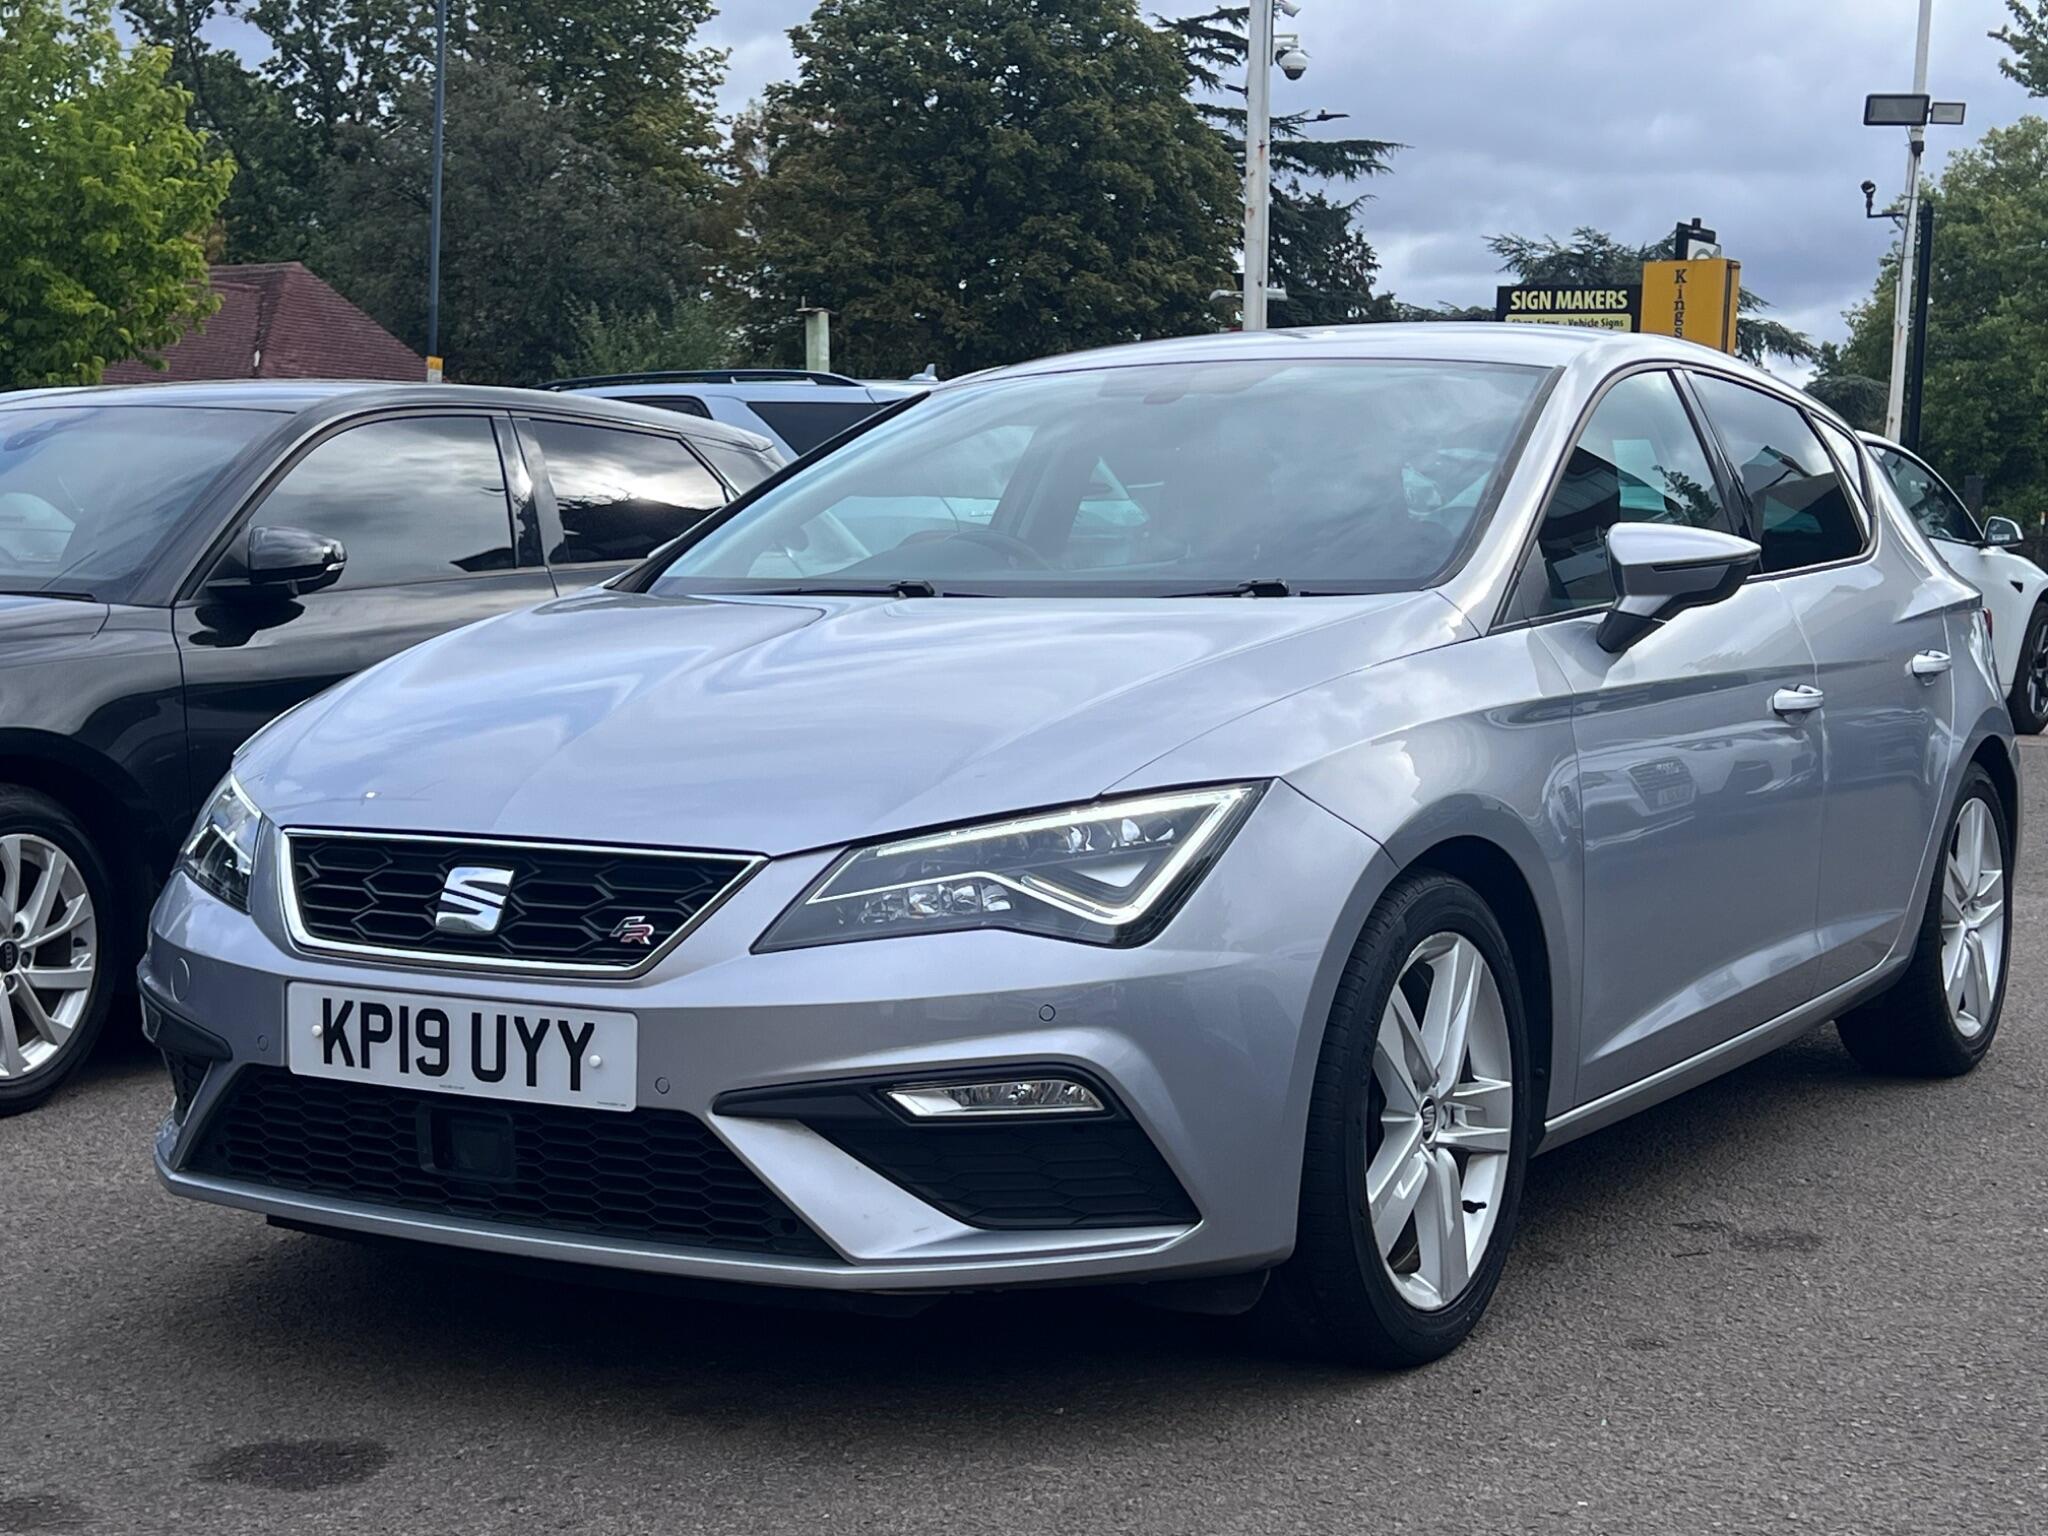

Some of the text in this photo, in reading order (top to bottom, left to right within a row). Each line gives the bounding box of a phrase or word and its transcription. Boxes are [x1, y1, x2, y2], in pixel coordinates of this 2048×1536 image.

[1510, 289, 1628, 310] SIGN MAKERS
[1601, 317, 1624, 329] Signs
[322, 998, 595, 1091] KP19 UYY
